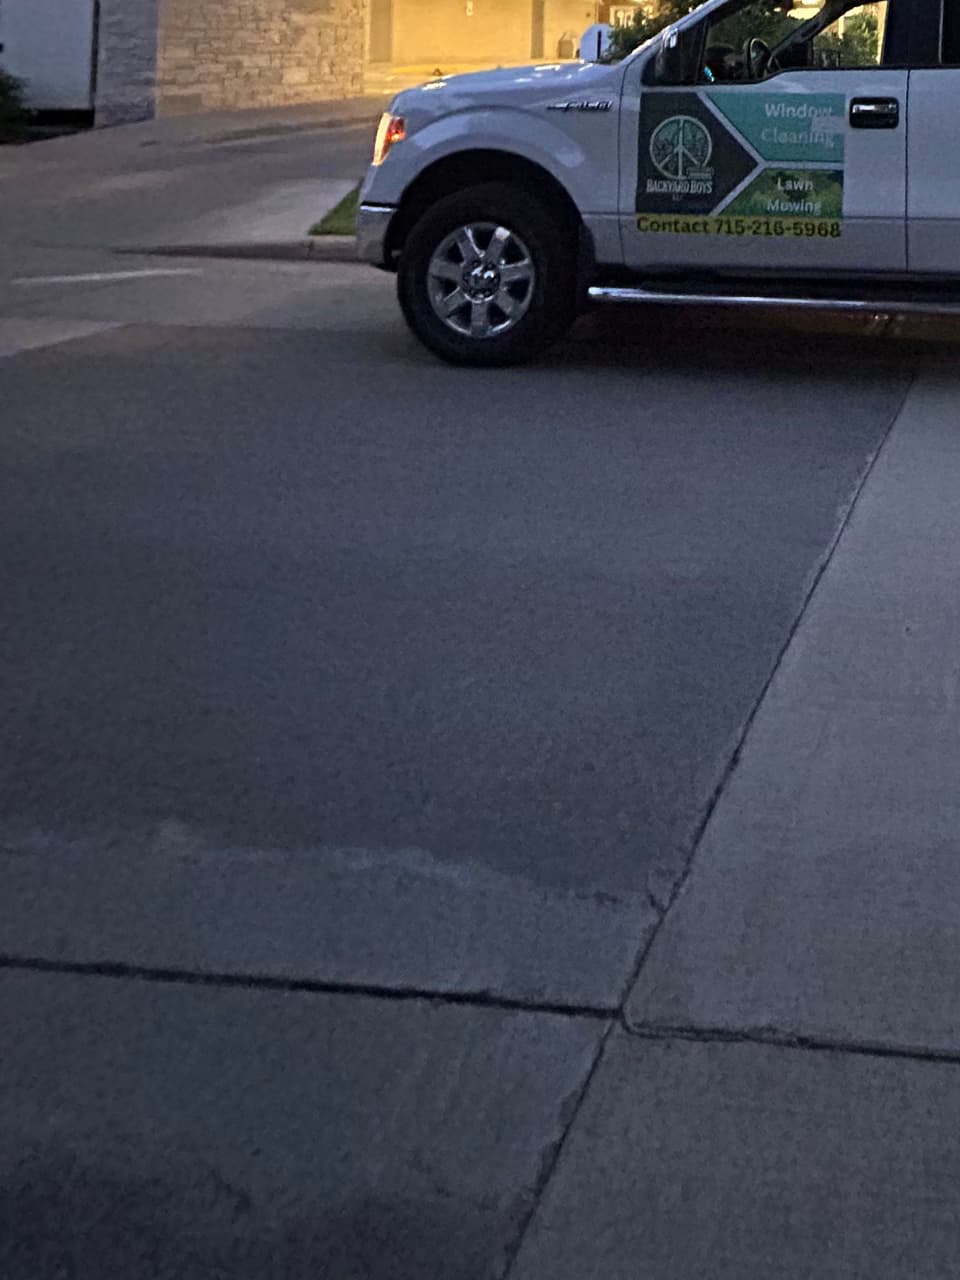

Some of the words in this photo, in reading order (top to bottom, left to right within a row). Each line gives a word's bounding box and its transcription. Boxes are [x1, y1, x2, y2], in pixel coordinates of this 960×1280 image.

[690, 180, 713, 194] BOYS
[777, 177, 814, 191] Lawn
[767, 199, 821, 216] Mowing
[637, 217, 709, 234] Contact
